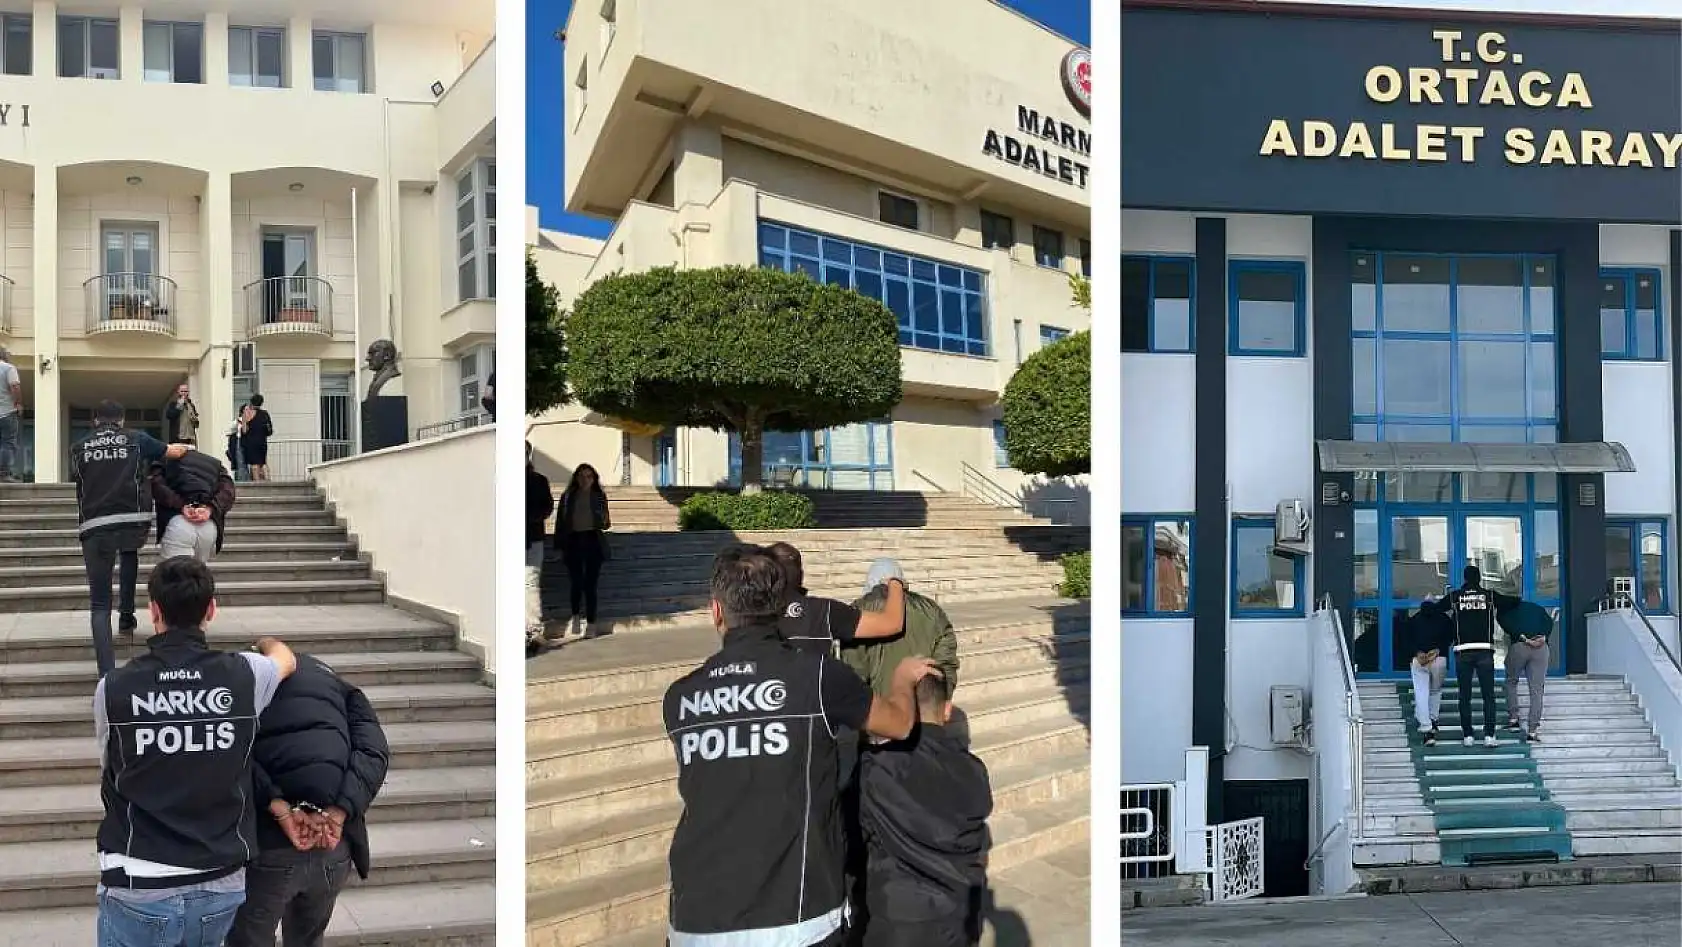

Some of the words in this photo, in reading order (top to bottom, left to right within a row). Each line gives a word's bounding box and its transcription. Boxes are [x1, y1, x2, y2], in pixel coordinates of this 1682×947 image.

[1433, 30, 1523, 64] T.C.
[1365, 65, 1594, 109] ORTACA
[982, 129, 1090, 189] ADALET
[1259, 119, 1484, 163] ADALET
[1504, 127, 1682, 169] SARAY
